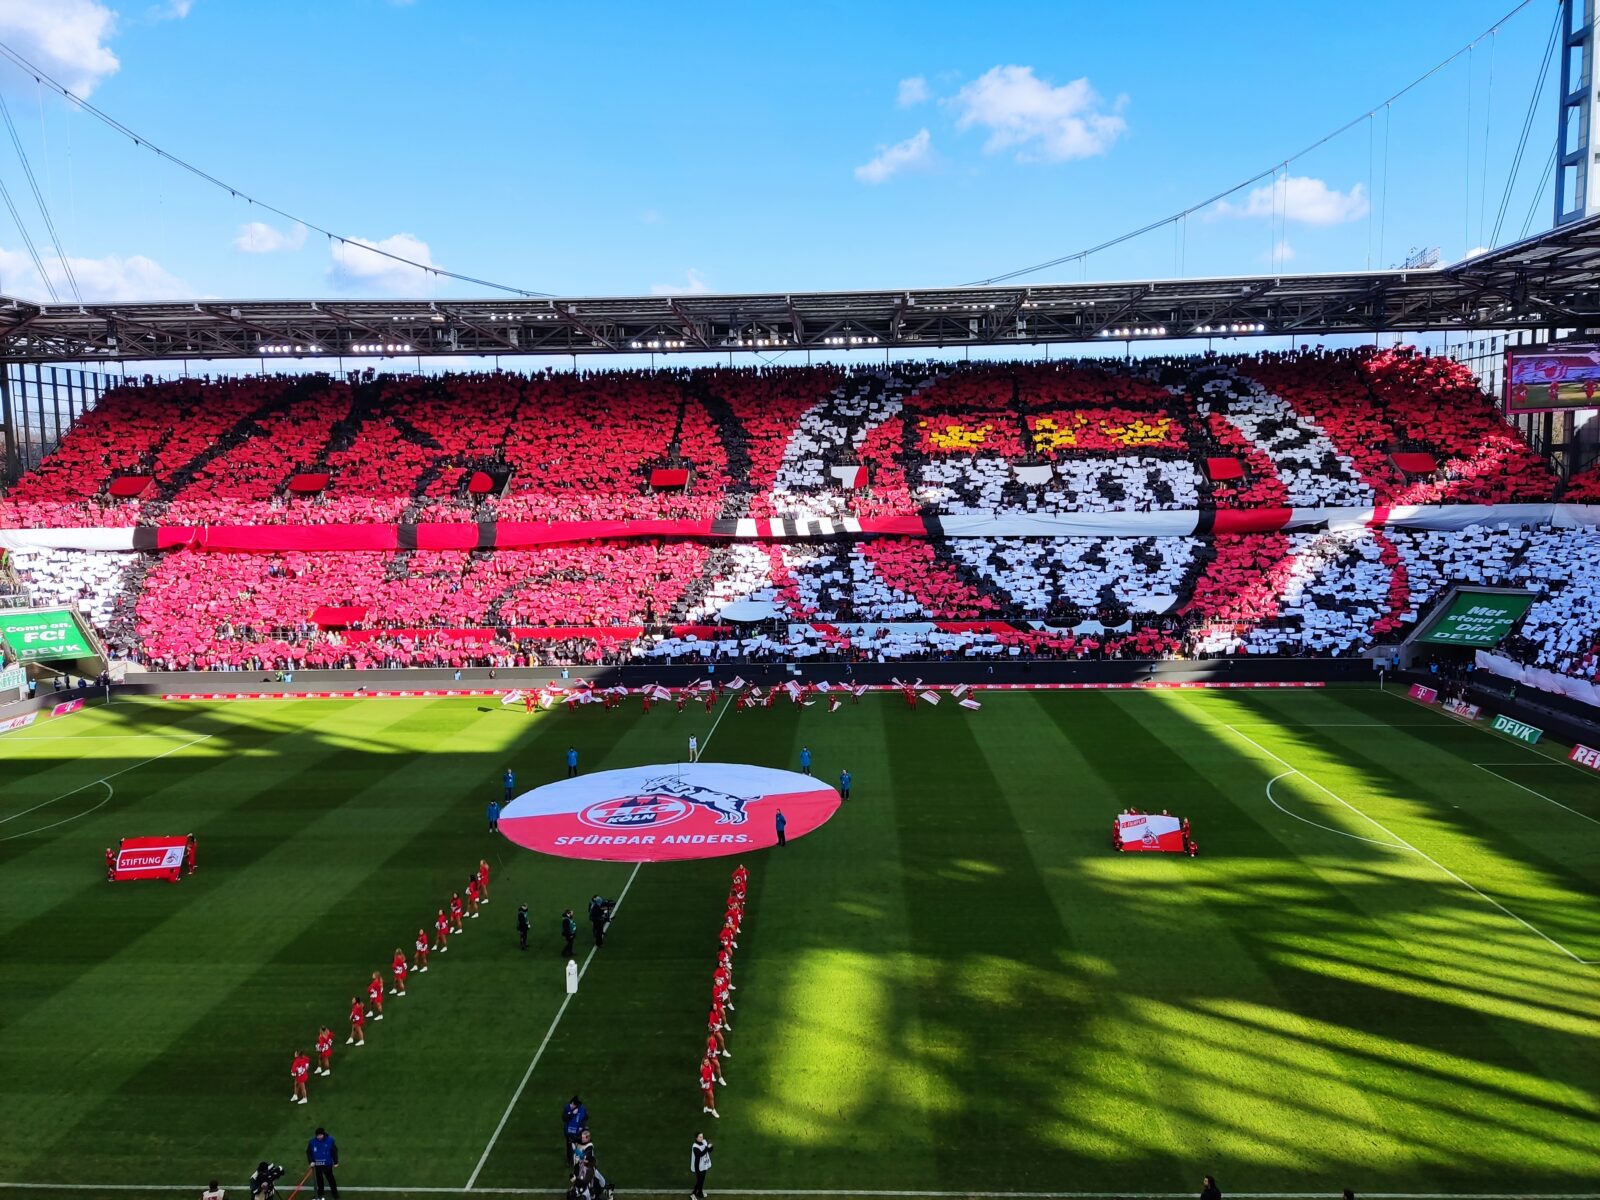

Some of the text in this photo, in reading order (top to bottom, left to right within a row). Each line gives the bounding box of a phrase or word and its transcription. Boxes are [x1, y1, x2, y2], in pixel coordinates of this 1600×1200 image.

[1467, 606, 1507, 616] Mer
[1448, 614, 1493, 624] stonn
[6, 624, 48, 633] Come
[24, 629, 65, 643] FC!
[1434, 632, 1495, 641] DEVK
[22, 645, 81, 656] DEVK
[1495, 718, 1534, 741] DEVK
[606, 813, 656, 824] KÖLN
[554, 833, 754, 846] SPÜRBAR ANDERS.
[121, 857, 160, 866] STIFTUNG
